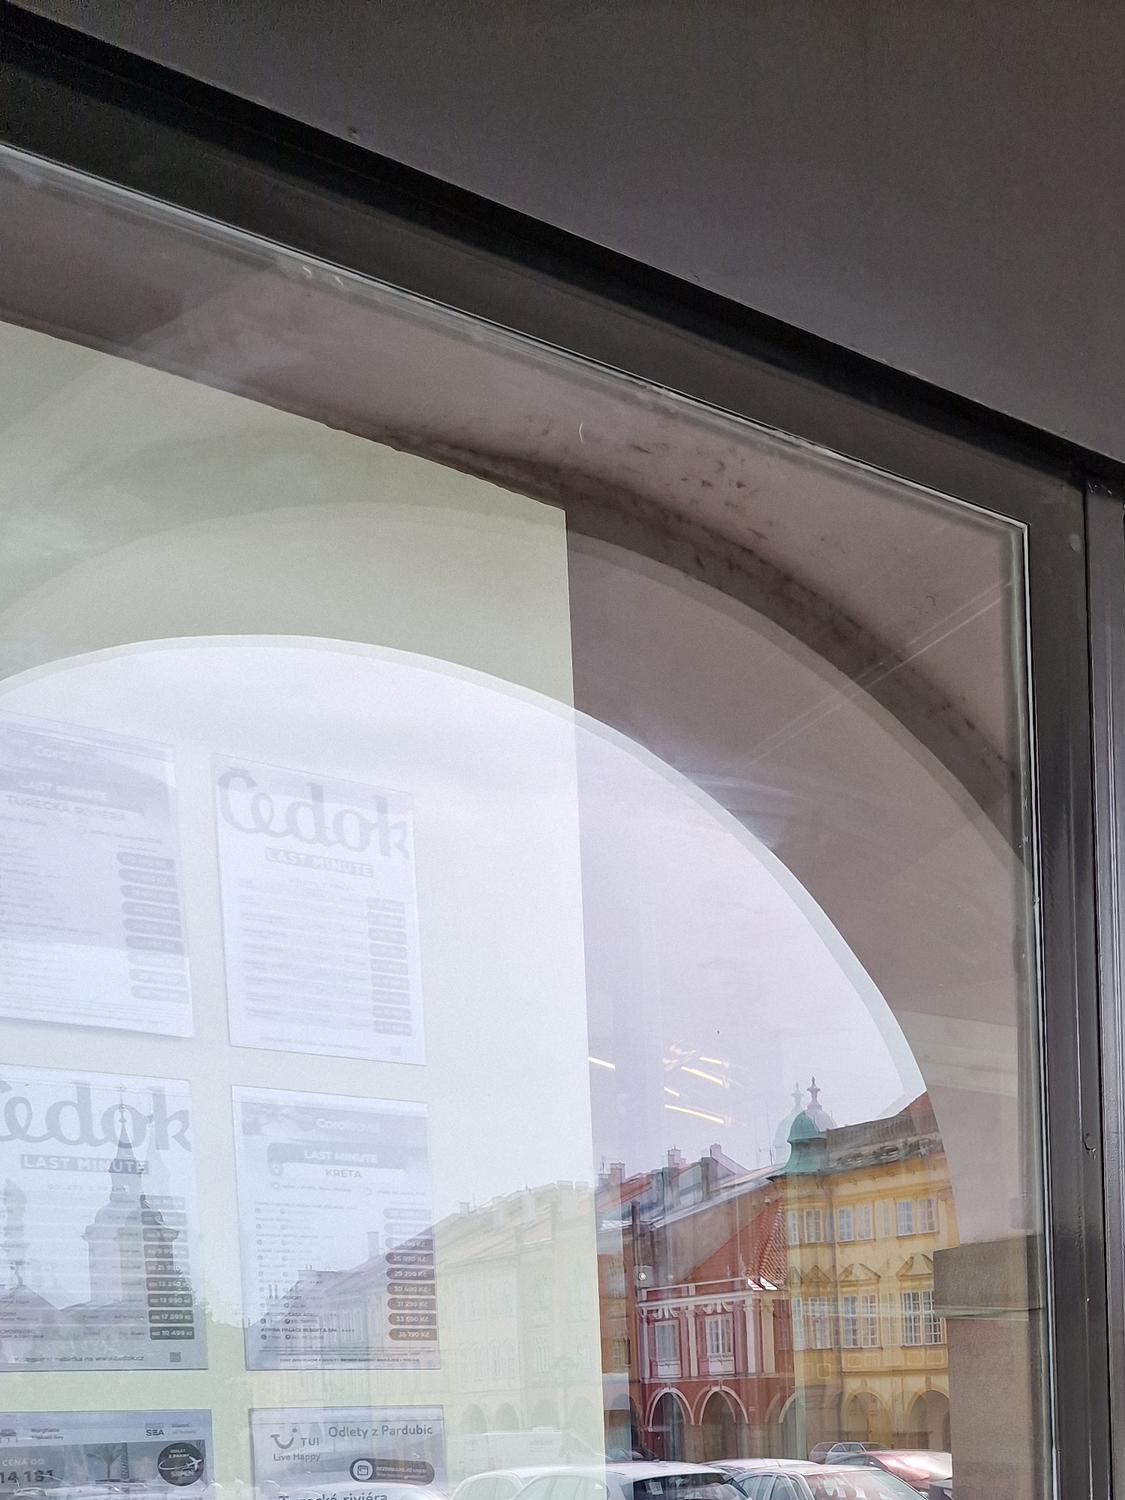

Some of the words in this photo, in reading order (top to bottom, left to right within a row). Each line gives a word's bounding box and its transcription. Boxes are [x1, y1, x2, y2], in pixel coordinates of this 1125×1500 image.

[0, 1079, 193, 1153] edok
[23, 1155, 71, 1169] LAST
[77, 1158, 147, 1174] MINUTE
[328, 1425, 369, 1439] Odlety
[371, 1428, 379, 1437] z
[381, 1424, 433, 1436] Pardubic
[273, 1453, 291, 1462] Live
[293, 1453, 321, 1463] Happy
